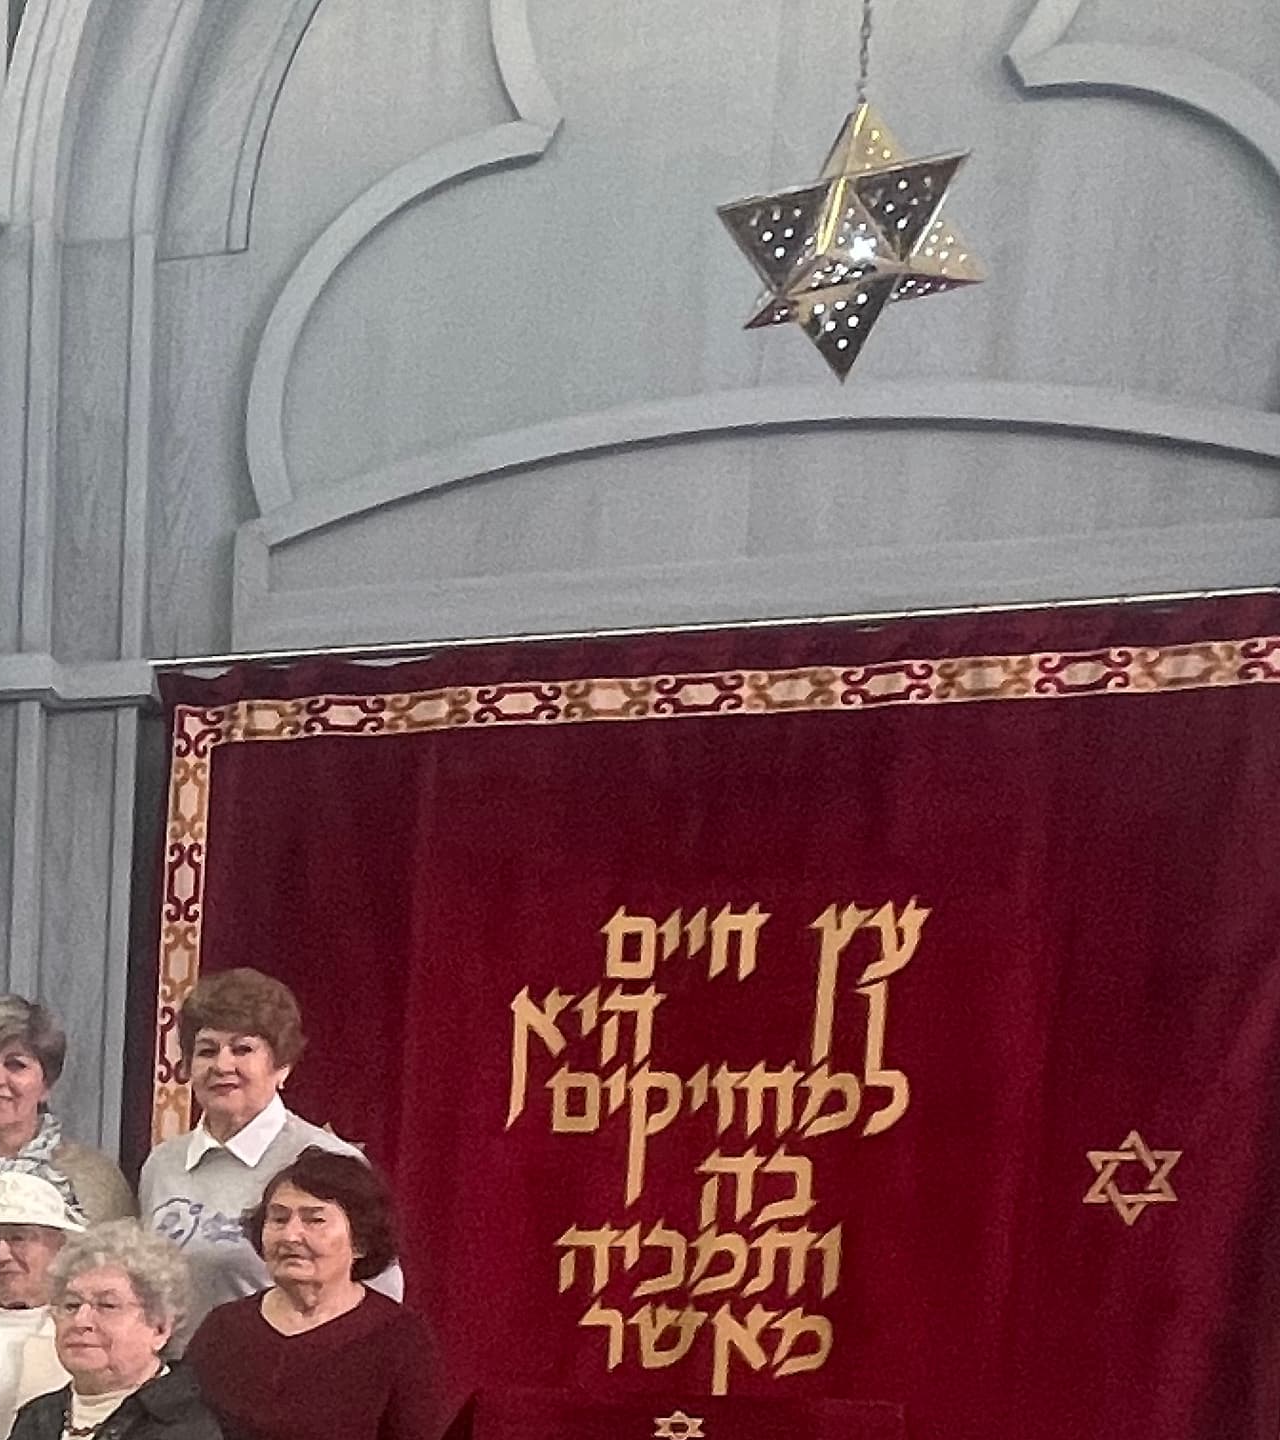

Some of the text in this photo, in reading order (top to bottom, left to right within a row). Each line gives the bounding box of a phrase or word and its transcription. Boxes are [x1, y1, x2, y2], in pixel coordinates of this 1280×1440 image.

[600, 895, 932, 1067] עץ חיים
[505, 983, 667, 1132] היא
[544, 979, 911, 1208] למחזיקים
[694, 1144, 818, 1230] בה
[553, 1218, 843, 1299] ותמכיה
[578, 1299, 834, 1397] מאשר
